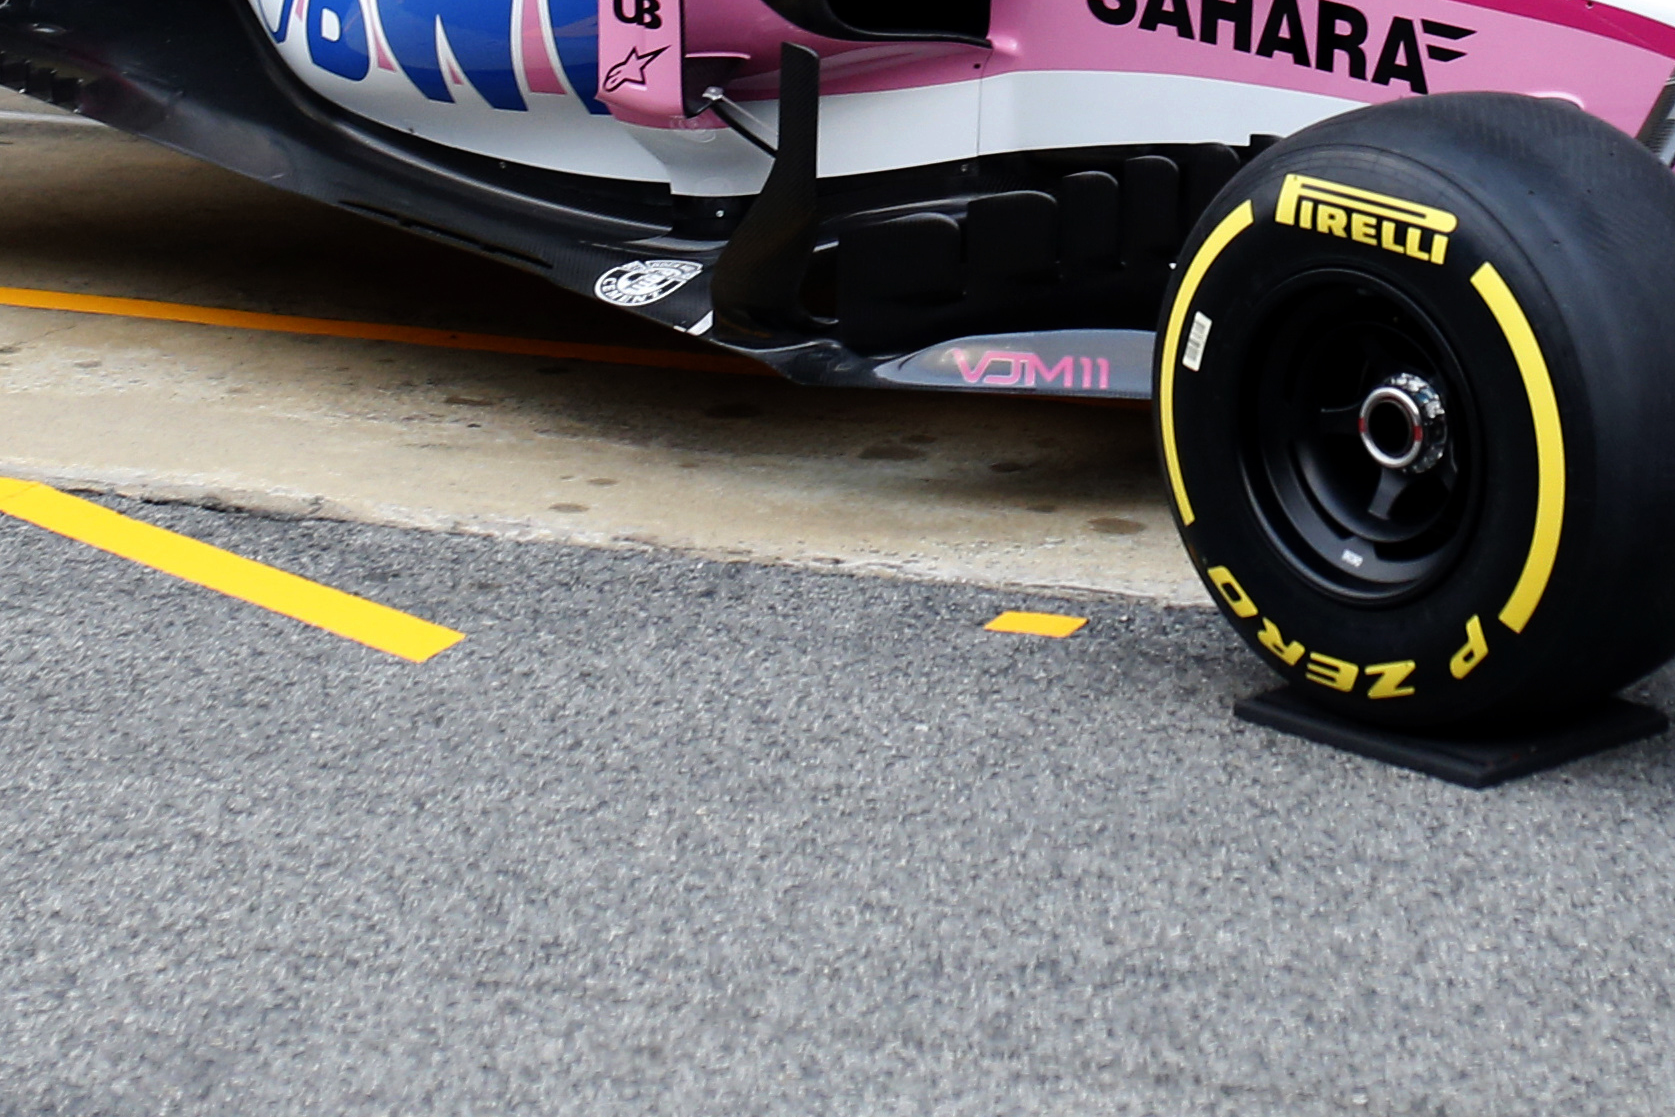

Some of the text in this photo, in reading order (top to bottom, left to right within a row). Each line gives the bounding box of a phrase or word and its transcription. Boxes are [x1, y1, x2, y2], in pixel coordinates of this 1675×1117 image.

[1275, 174, 1458, 265] PIRELLI
[1207, 565, 1490, 699] P ZERO
